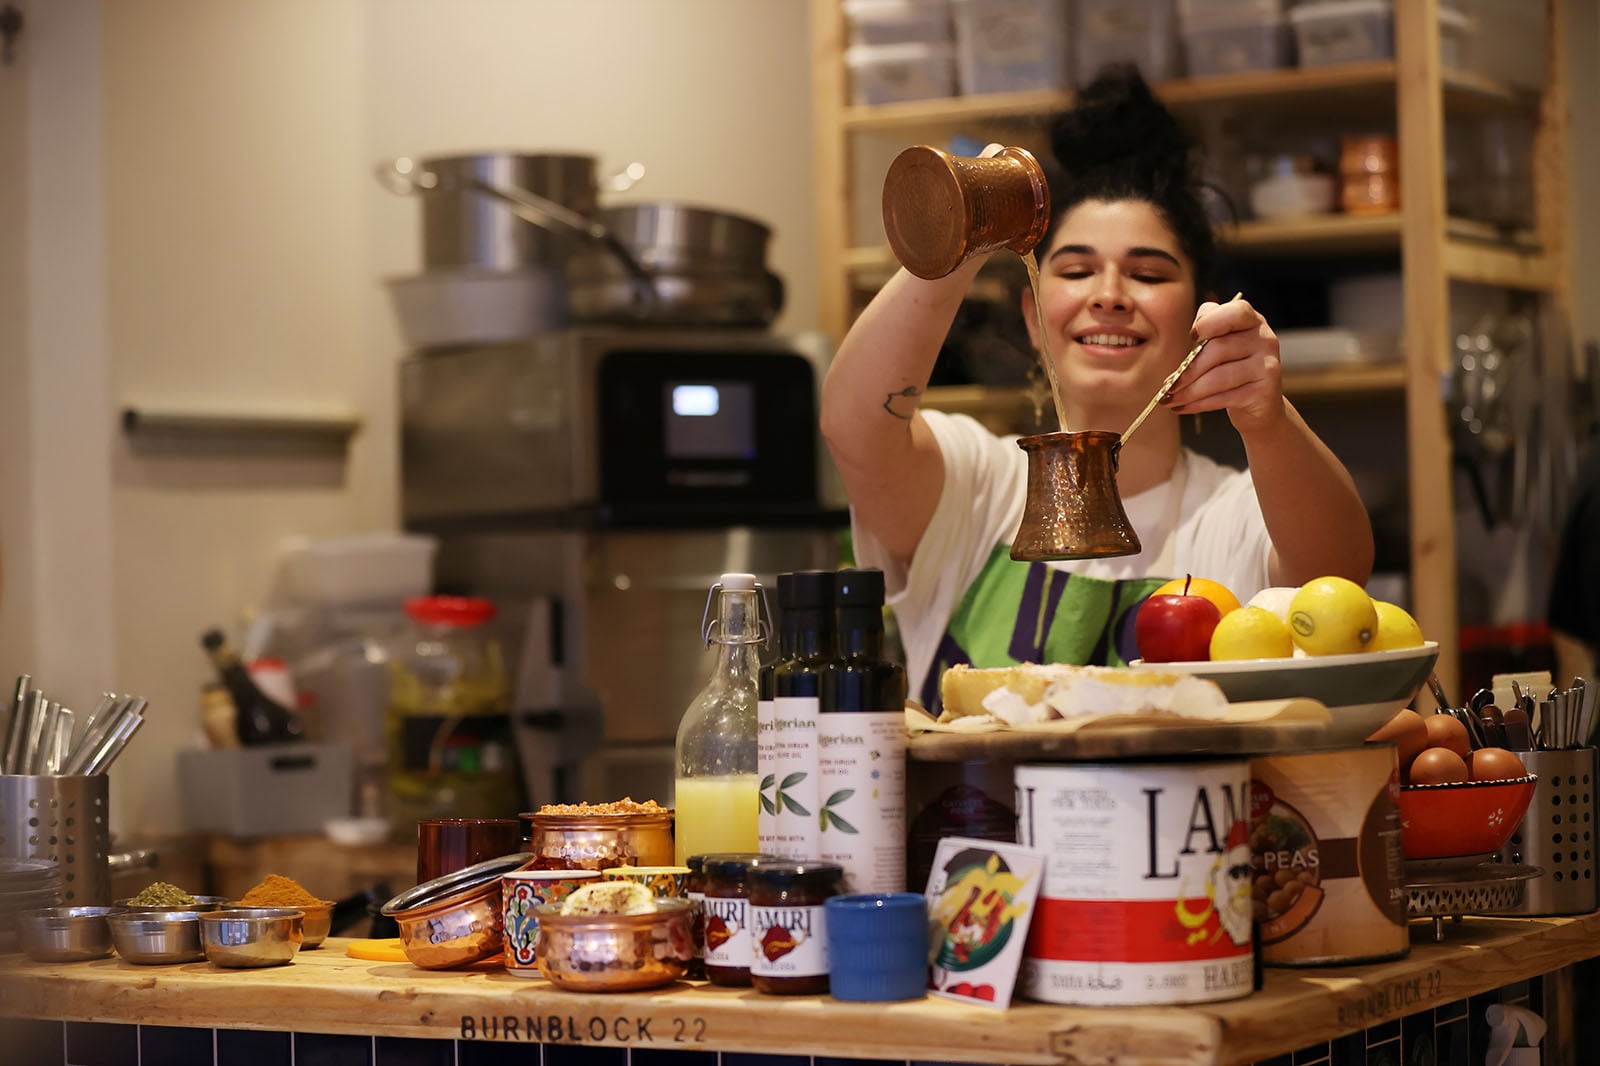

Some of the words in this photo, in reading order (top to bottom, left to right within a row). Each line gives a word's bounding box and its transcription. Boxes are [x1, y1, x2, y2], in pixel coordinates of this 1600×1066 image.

[1264, 849, 1320, 870] PEAS
[461, 1015, 654, 1042] BURNBLOCK
[673, 1018, 707, 1042] 22
